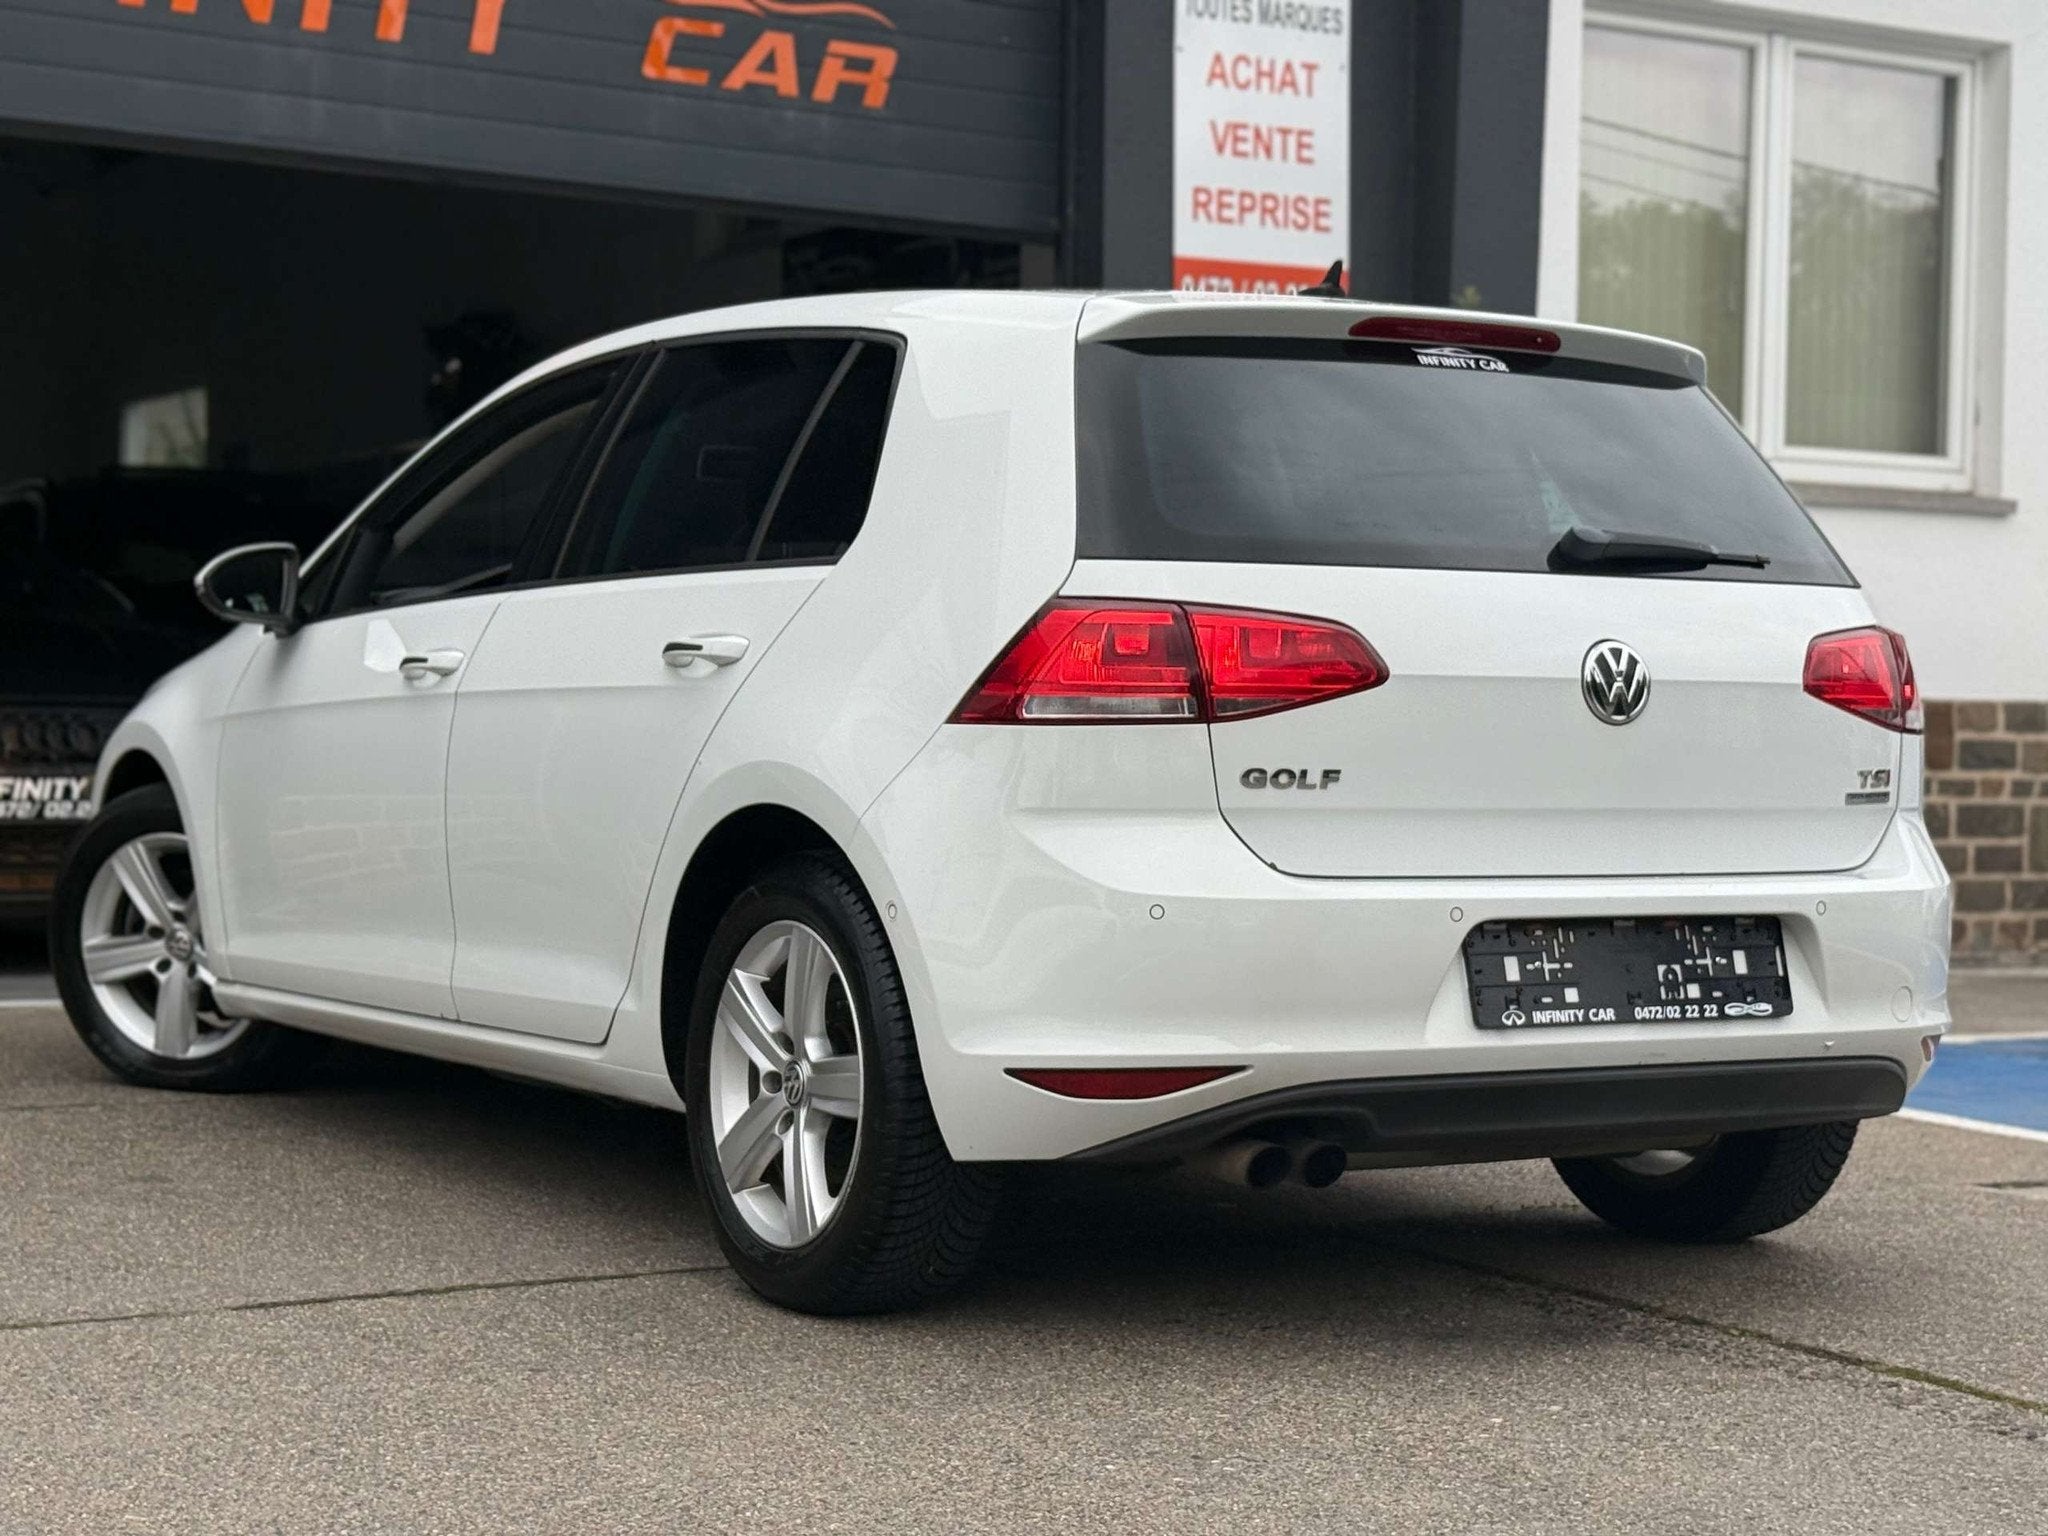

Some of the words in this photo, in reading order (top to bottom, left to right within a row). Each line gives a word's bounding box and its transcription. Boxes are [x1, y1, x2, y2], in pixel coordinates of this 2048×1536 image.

[1257, 0, 1344, 35] MARQUES
[641, 15, 898, 110] CAR
[1206, 52, 1319, 97] ACHAT
[1209, 120, 1316, 165] VENTE
[1191, 186, 1332, 234] REPRISE
[1416, 354, 1476, 370] INFINITY
[1479, 358, 1511, 374] CAR
[0, 776, 88, 801] FINITY
[1239, 767, 1342, 790] GOLF
[1857, 768, 1891, 789] TSI
[1532, 1008, 1585, 1025] INFINITY
[1588, 1007, 1616, 1022] CAR
[1634, 1005, 1682, 1020] 0472/02
[1685, 1004, 1700, 1019] 22
[1704, 1003, 1719, 1018] 22
